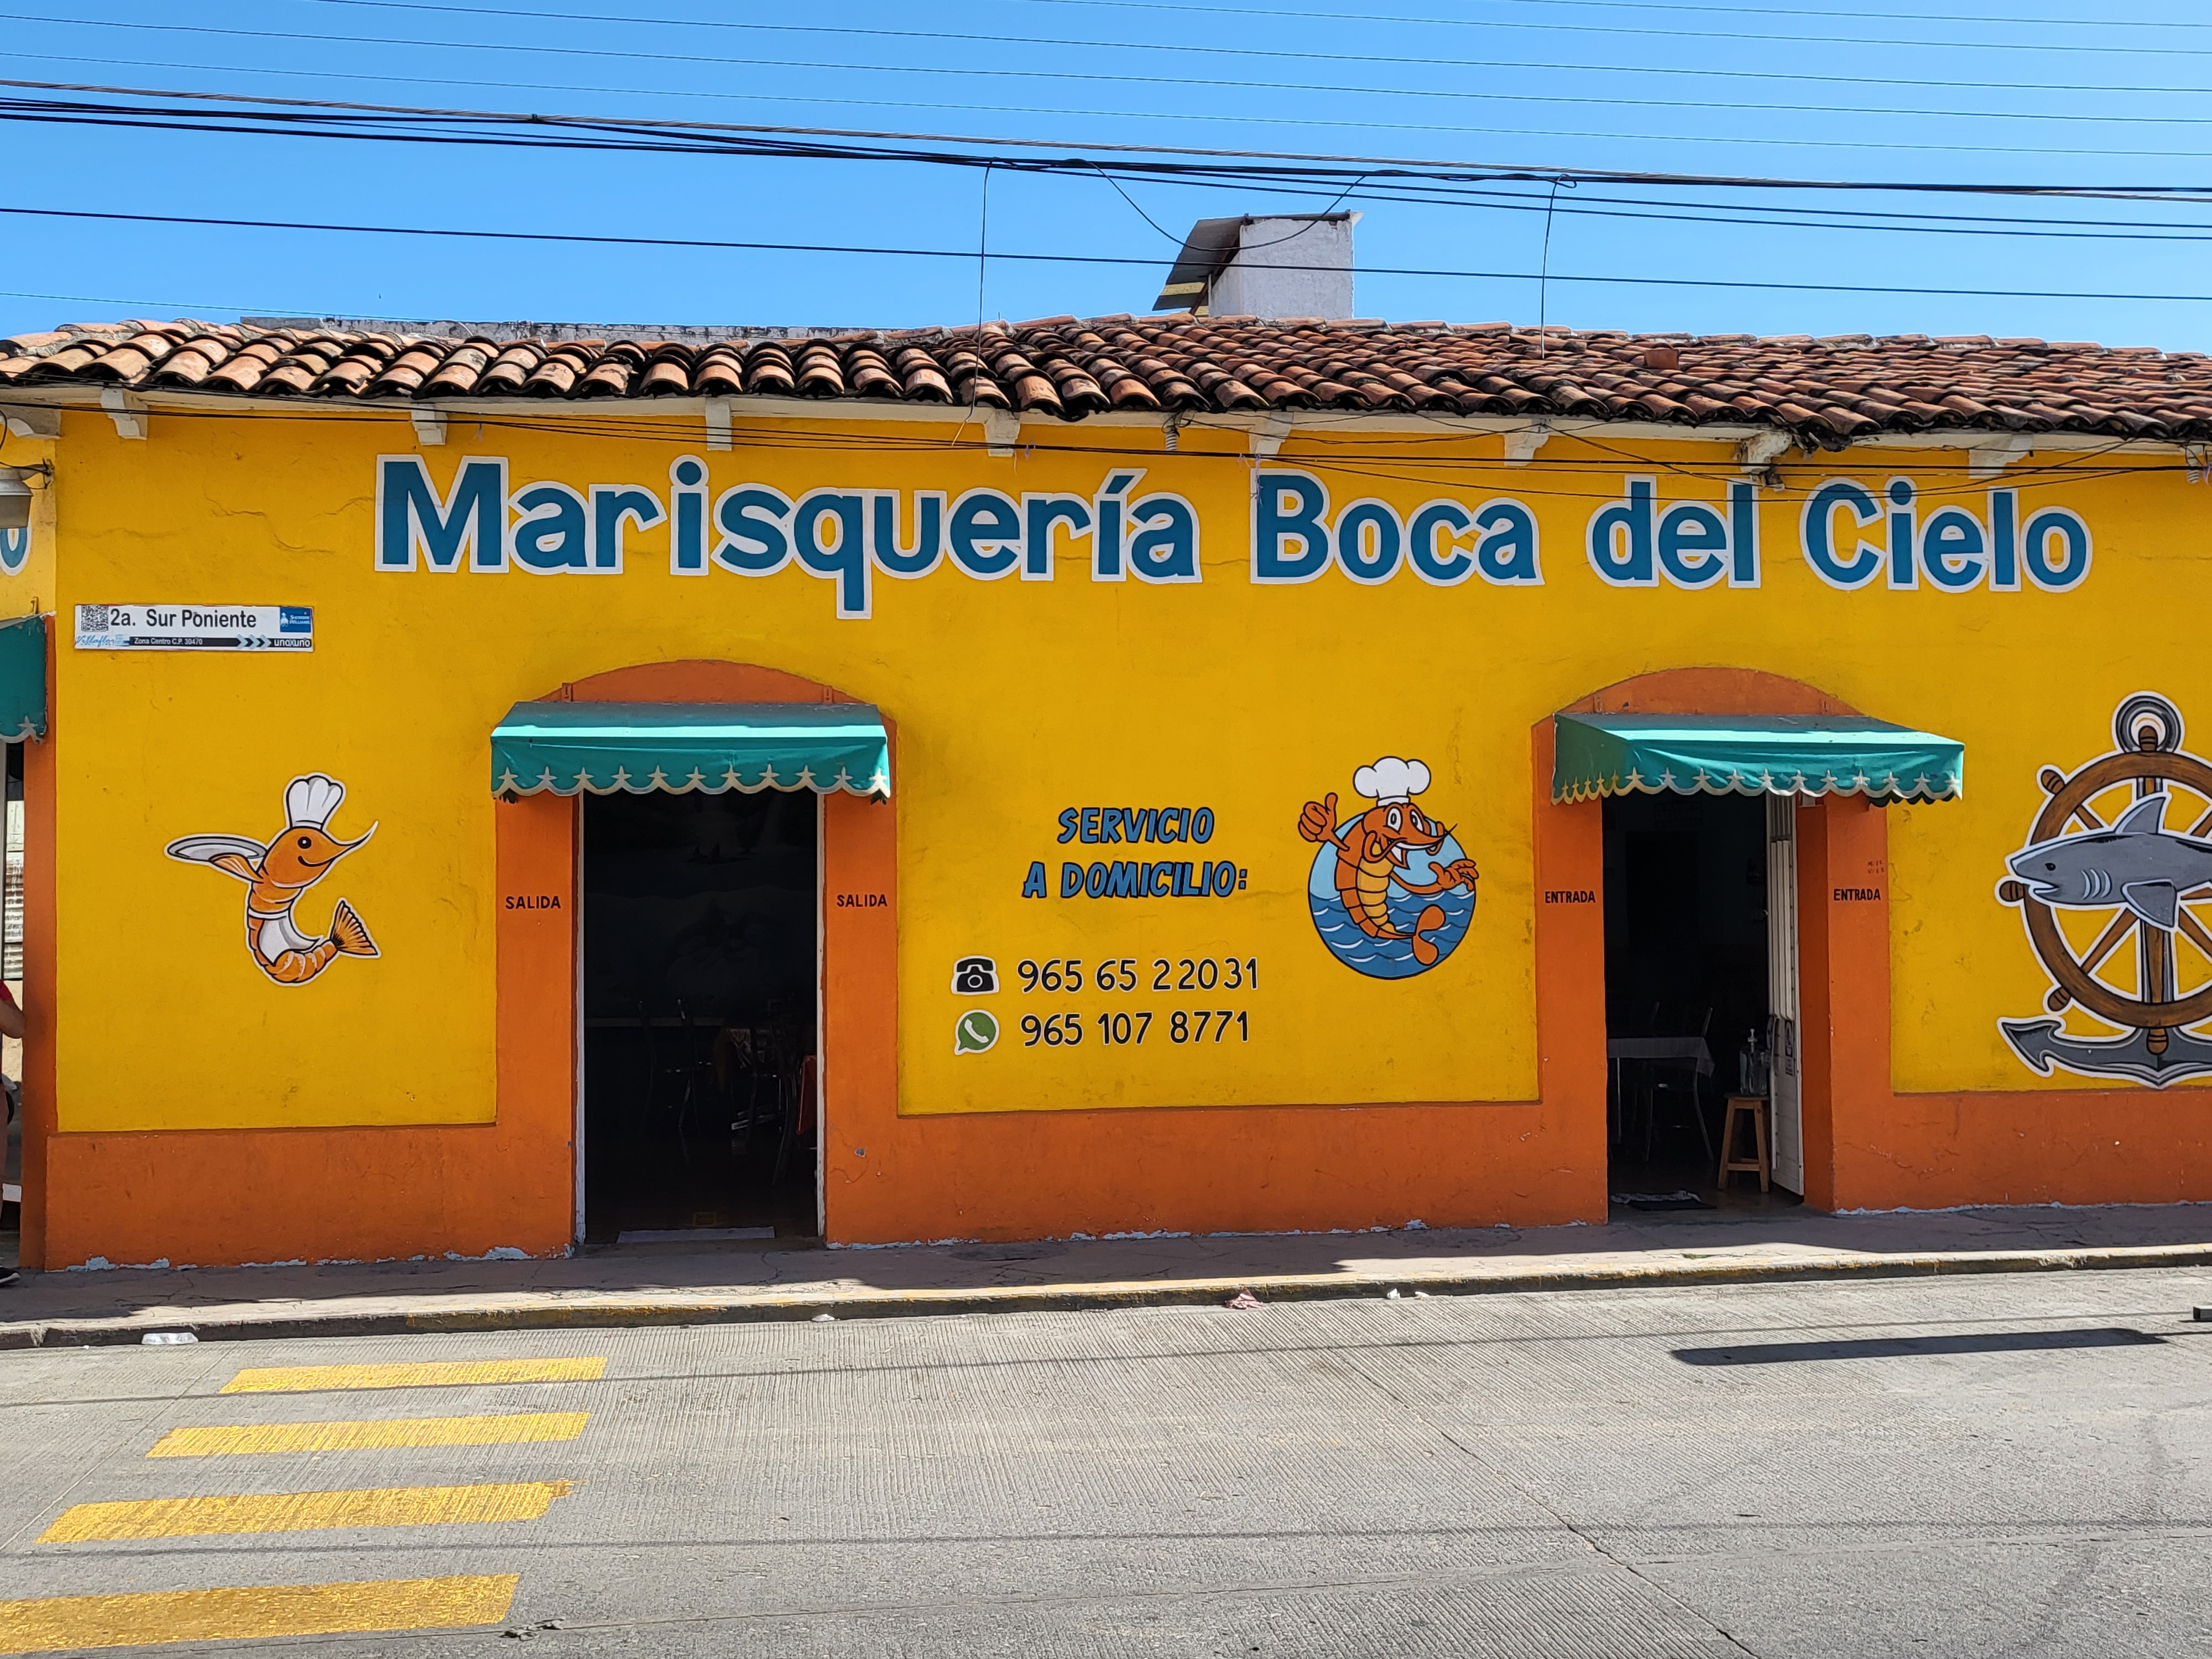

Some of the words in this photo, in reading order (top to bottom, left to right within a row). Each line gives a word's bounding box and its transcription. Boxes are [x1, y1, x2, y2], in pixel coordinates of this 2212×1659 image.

[375, 454, 1202, 620] Marisquería
[1250, 468, 1545, 586] Boca
[1585, 475, 1761, 589] del
[1799, 476, 2093, 593] Cielo
[110, 608, 136, 626] 2a.
[146, 608, 177, 627] Sur
[181, 609, 257, 628] Poniente
[1057, 807, 1215, 844] SERVICIO
[1021, 861, 1047, 899] A
[1060, 860, 1248, 899] DOMICILIO:
[505, 895, 561, 910] SALIDA
[836, 894, 888, 907] SALIDA
[1545, 890, 1596, 904] ENTRADA
[1833, 888, 1881, 901] ENTRADA
[1017, 958, 1084, 993] 965
[1096, 958, 1138, 992] 65
[1152, 957, 1258, 992] 22031
[1020, 1013, 1083, 1047] 965
[1097, 1011, 1153, 1045] 107
[1169, 1010, 1248, 1044] 8771
